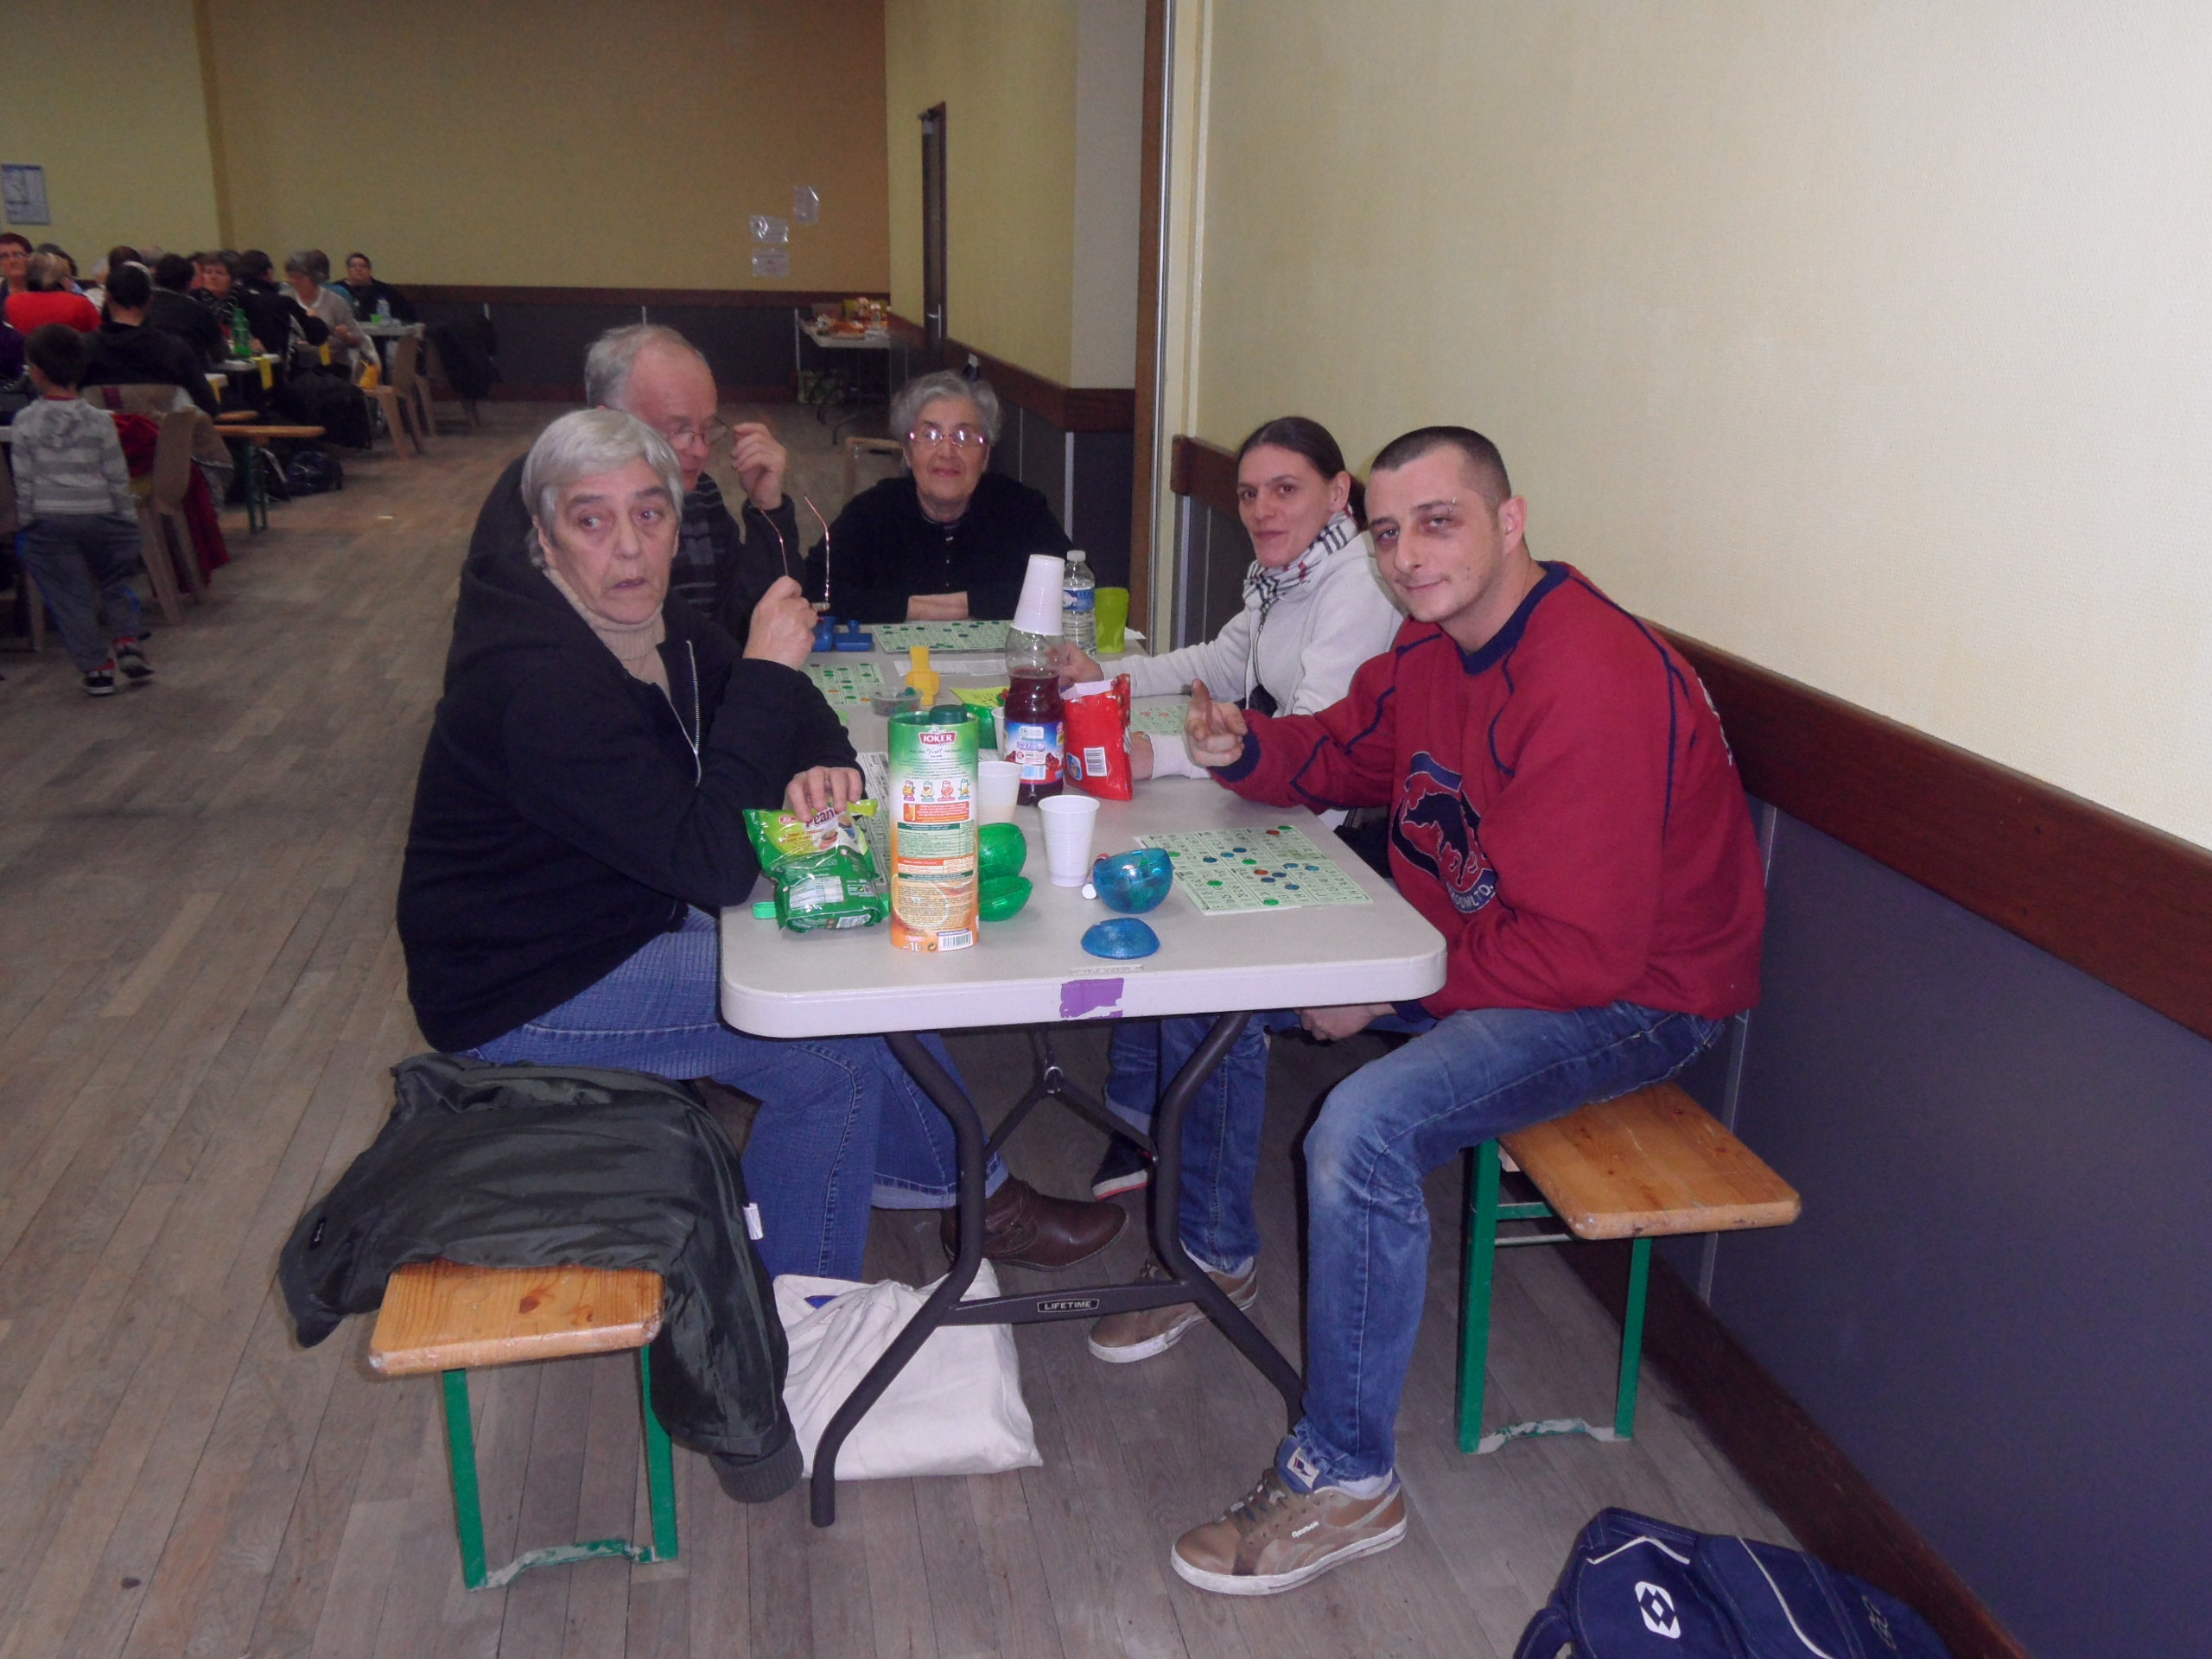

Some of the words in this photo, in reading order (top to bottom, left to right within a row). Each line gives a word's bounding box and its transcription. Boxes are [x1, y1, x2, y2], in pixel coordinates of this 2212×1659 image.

[923, 734, 952, 743] JOKER
[1044, 1300, 1091, 1310] LIFETIME
[1292, 1521, 1319, 1538] Reebok
